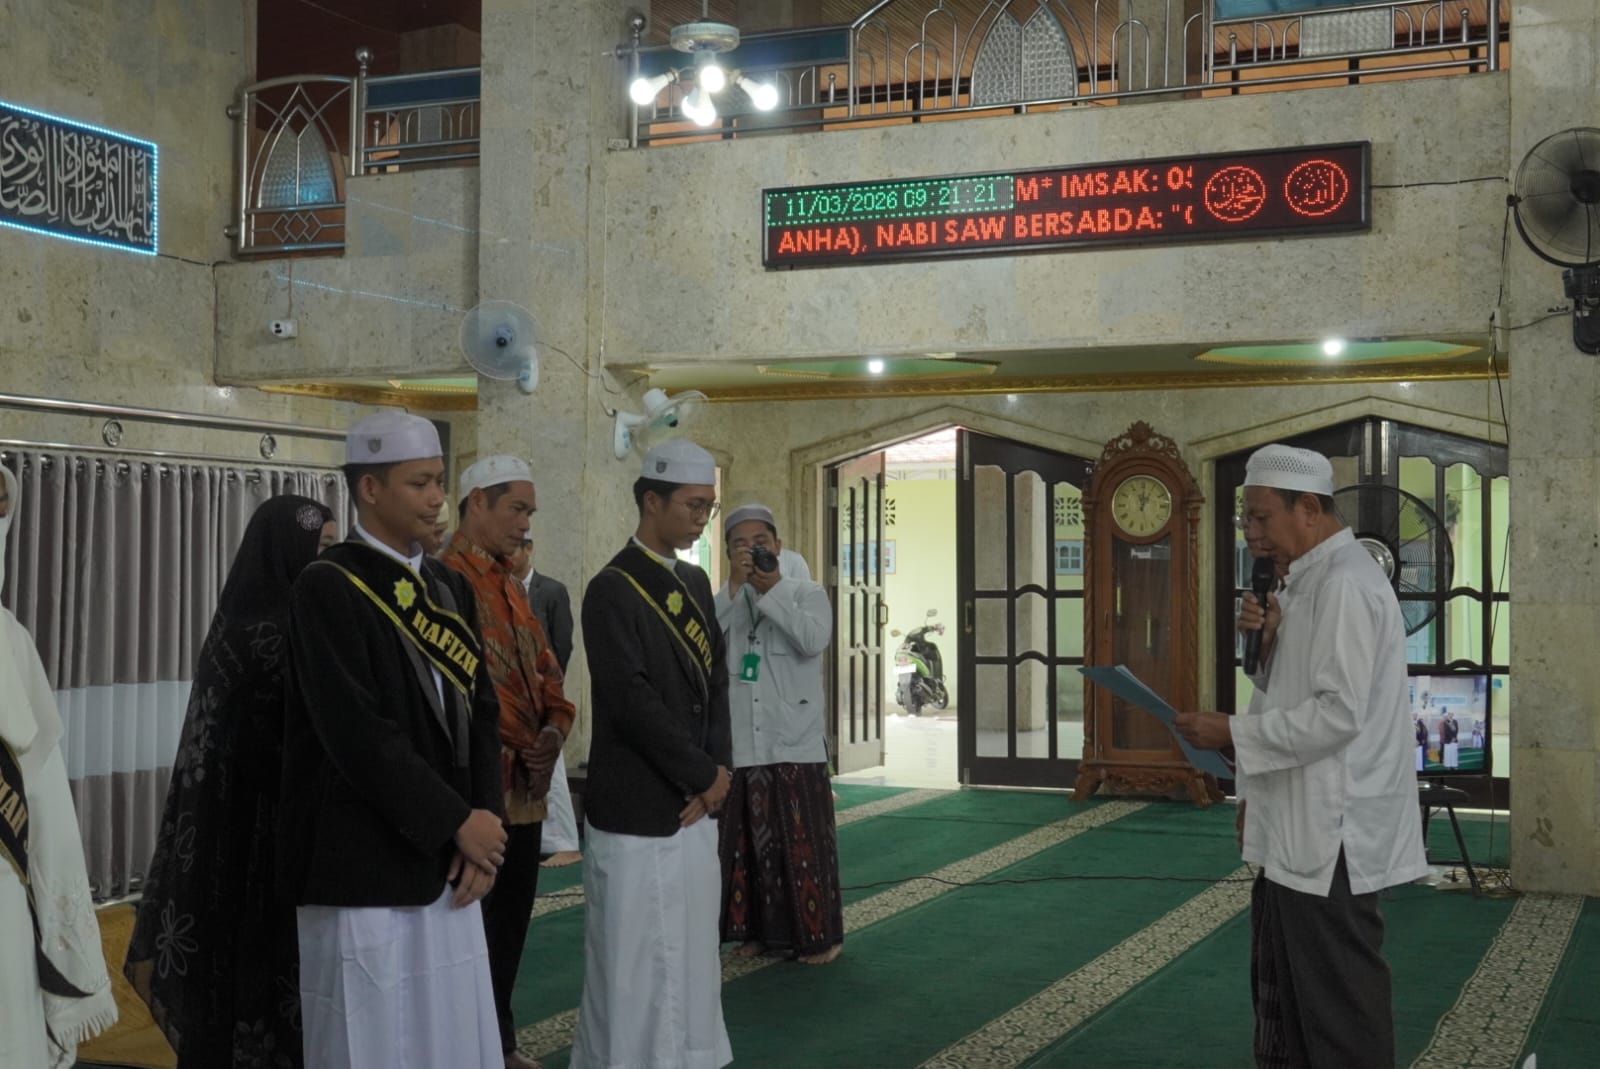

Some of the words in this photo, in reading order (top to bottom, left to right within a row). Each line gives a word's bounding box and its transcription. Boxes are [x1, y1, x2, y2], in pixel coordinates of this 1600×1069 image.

[1061, 168, 1158, 198] IMSAK:
[787, 192, 898, 217] 11/03/2026
[877, 221, 937, 248] NABI
[945, 216, 1006, 243] SAW
[1015, 206, 1163, 239] BERSABDA:
[411, 609, 479, 678] HAFIZH
